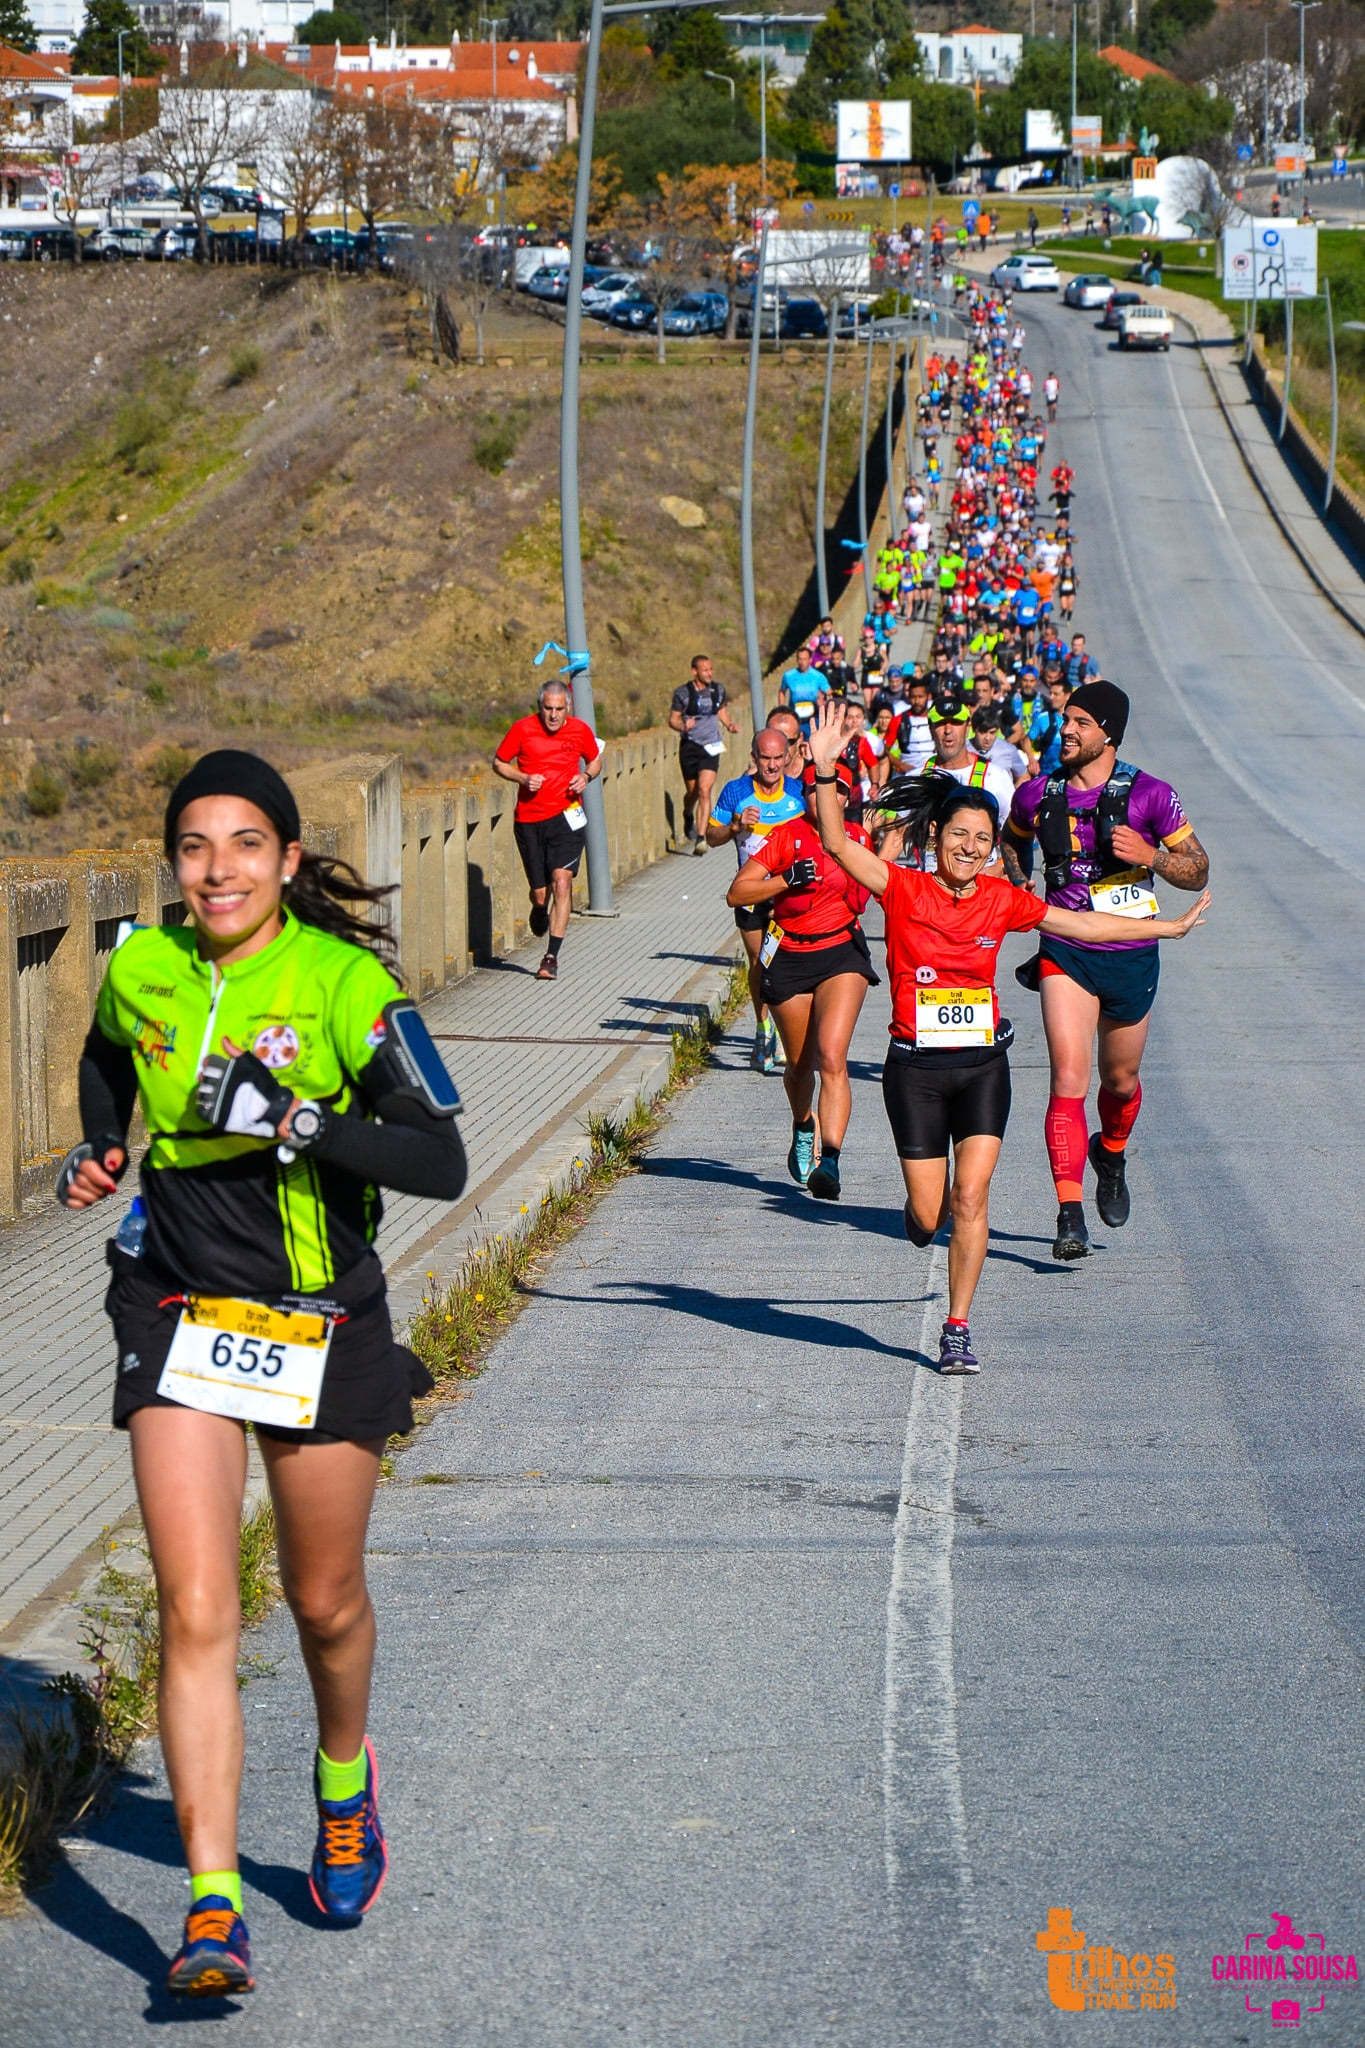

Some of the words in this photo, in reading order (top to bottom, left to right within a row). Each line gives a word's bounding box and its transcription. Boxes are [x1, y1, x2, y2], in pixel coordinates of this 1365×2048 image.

[1110, 884, 1140, 905] 676
[938, 1005, 975, 1025] 680
[245, 1309, 271, 1323] trail
[237, 1322, 272, 1337] curto
[211, 1332, 287, 1378] 655
